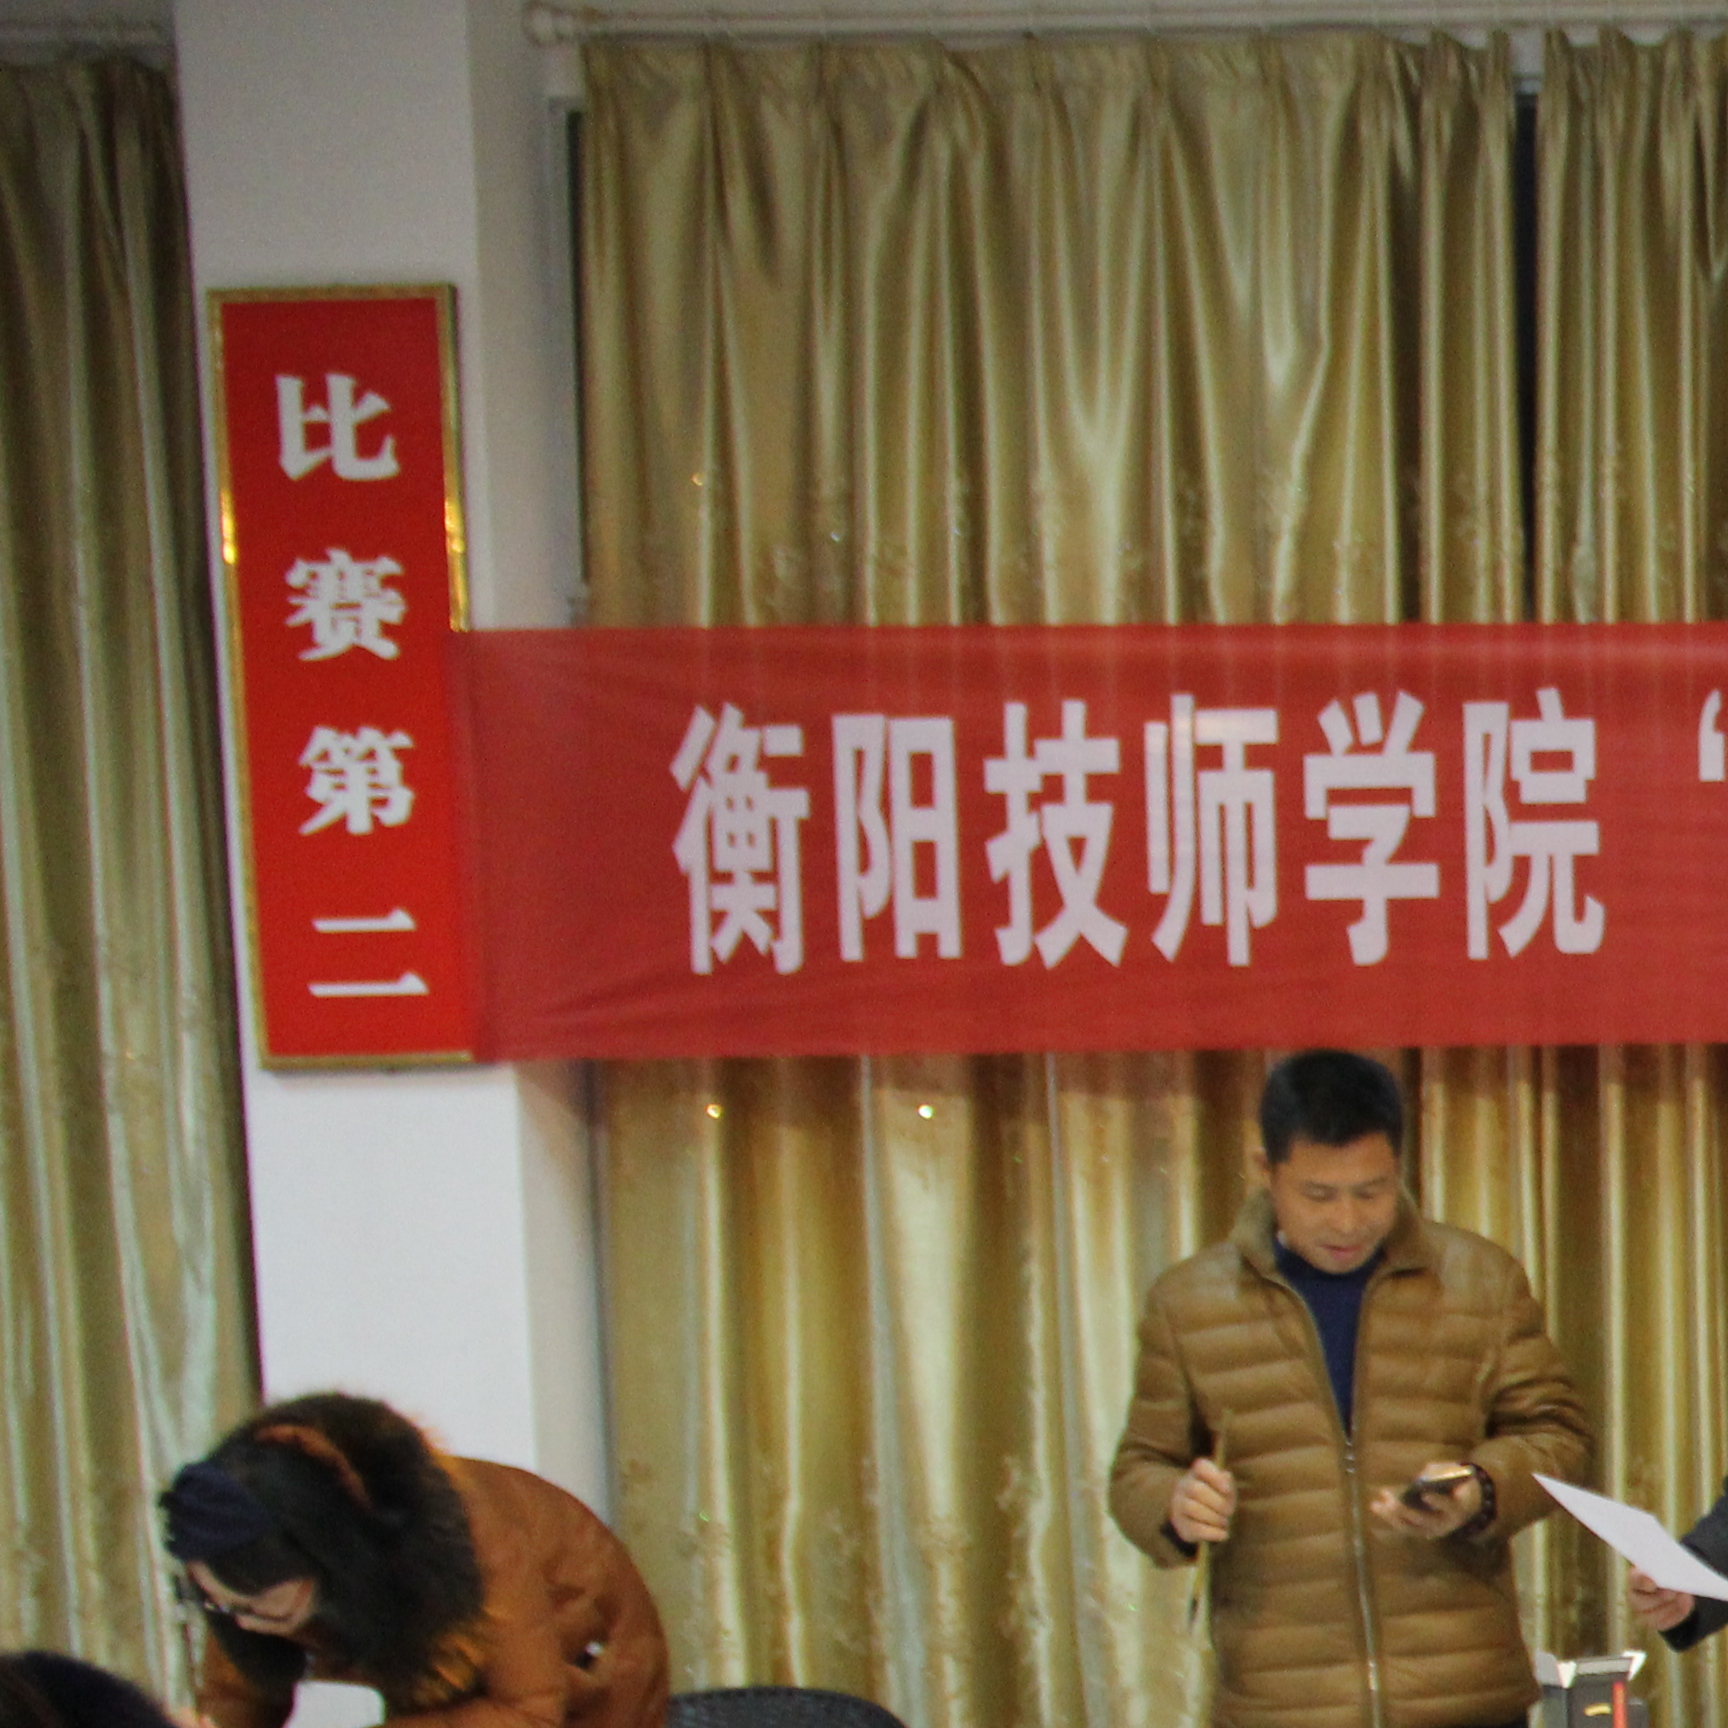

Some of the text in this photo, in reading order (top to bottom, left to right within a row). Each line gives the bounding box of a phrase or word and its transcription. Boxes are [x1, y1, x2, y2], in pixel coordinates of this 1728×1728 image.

[273, 372, 429, 999] 比赛第二
[668, 686, 1606, 976] 衡阳技师学院
